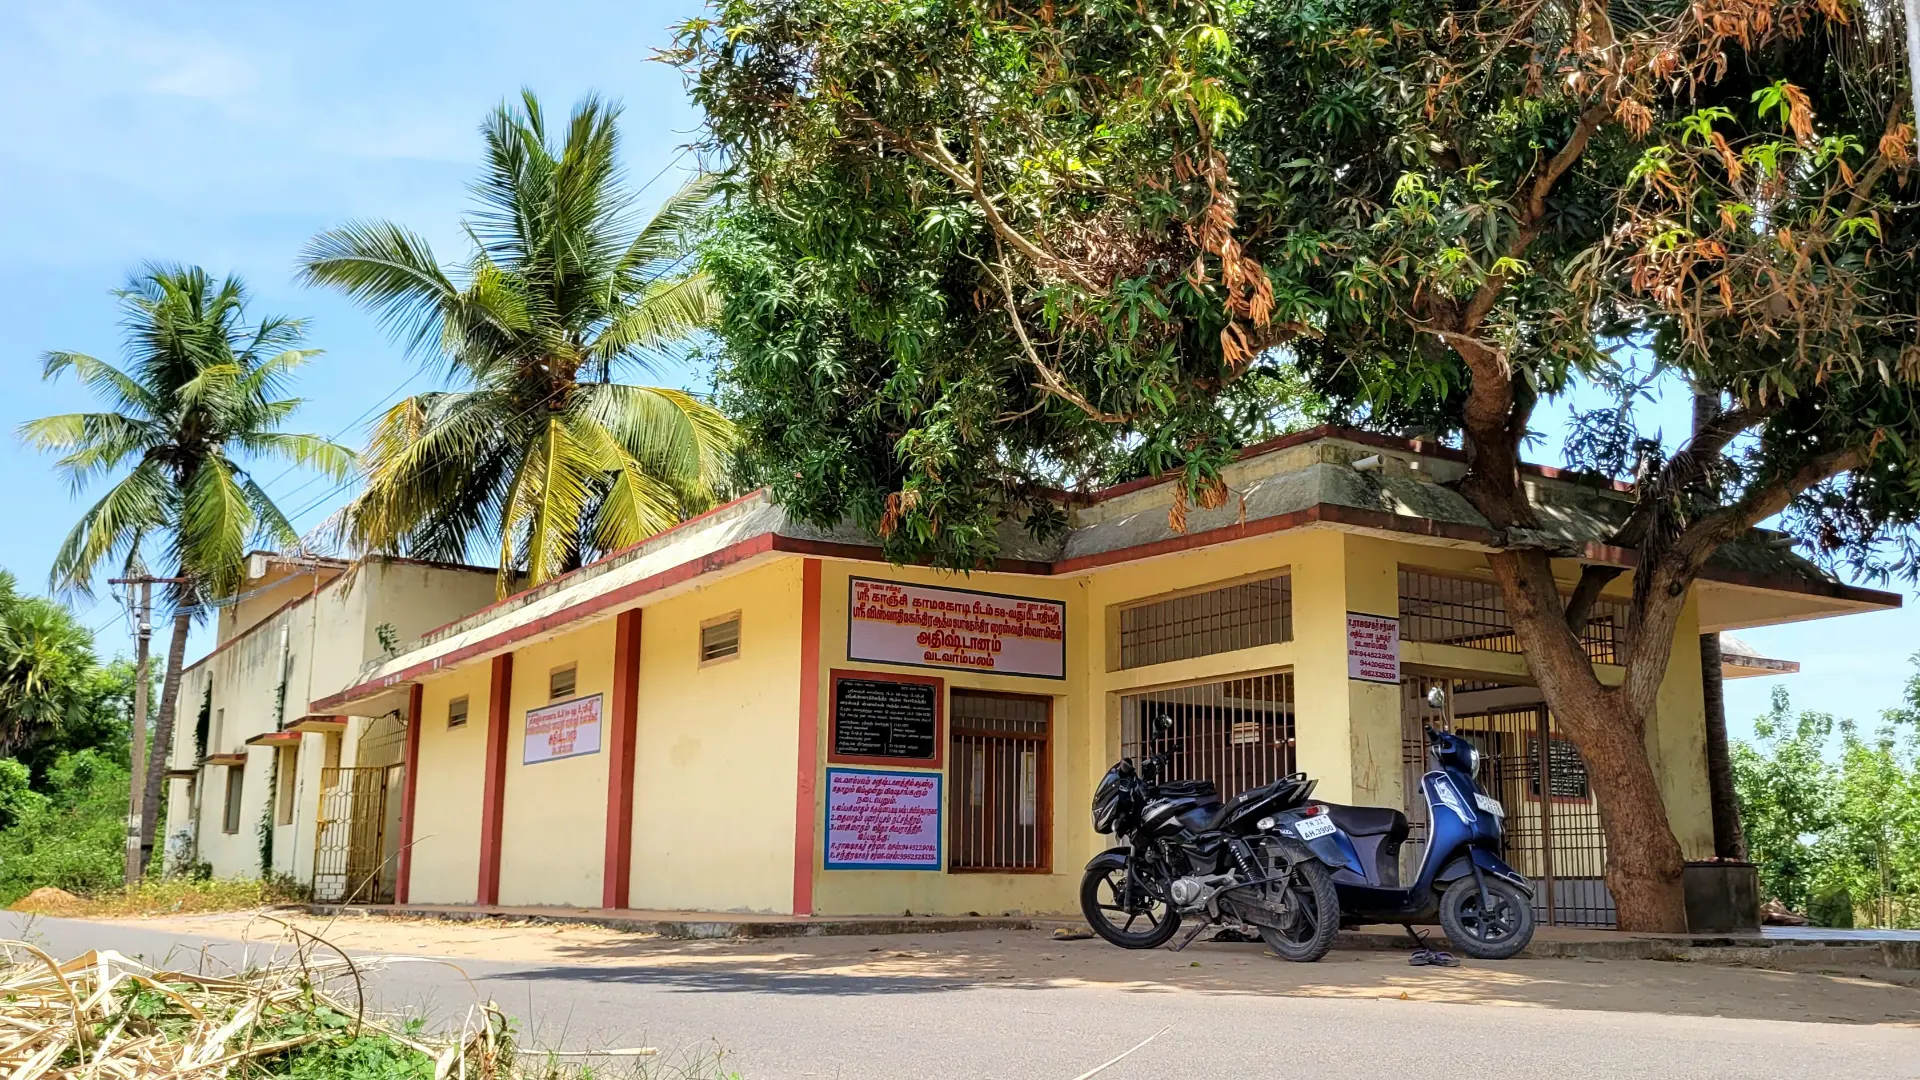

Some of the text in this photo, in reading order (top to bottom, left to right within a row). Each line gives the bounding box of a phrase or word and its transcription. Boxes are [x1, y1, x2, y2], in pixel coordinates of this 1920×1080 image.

[872, 592, 908, 607] காஞ்சி
[912, 598, 972, 617] காமகோடி
[973, 601, 993, 616] பீடம்
[994, 607, 1026, 622] 58-வது
[1026, 609, 1060, 625] பீடாதிபதி
[917, 628, 1002, 653] அதிஷ்டானம்
[924, 649, 995, 667] வடவாம்பலம்
